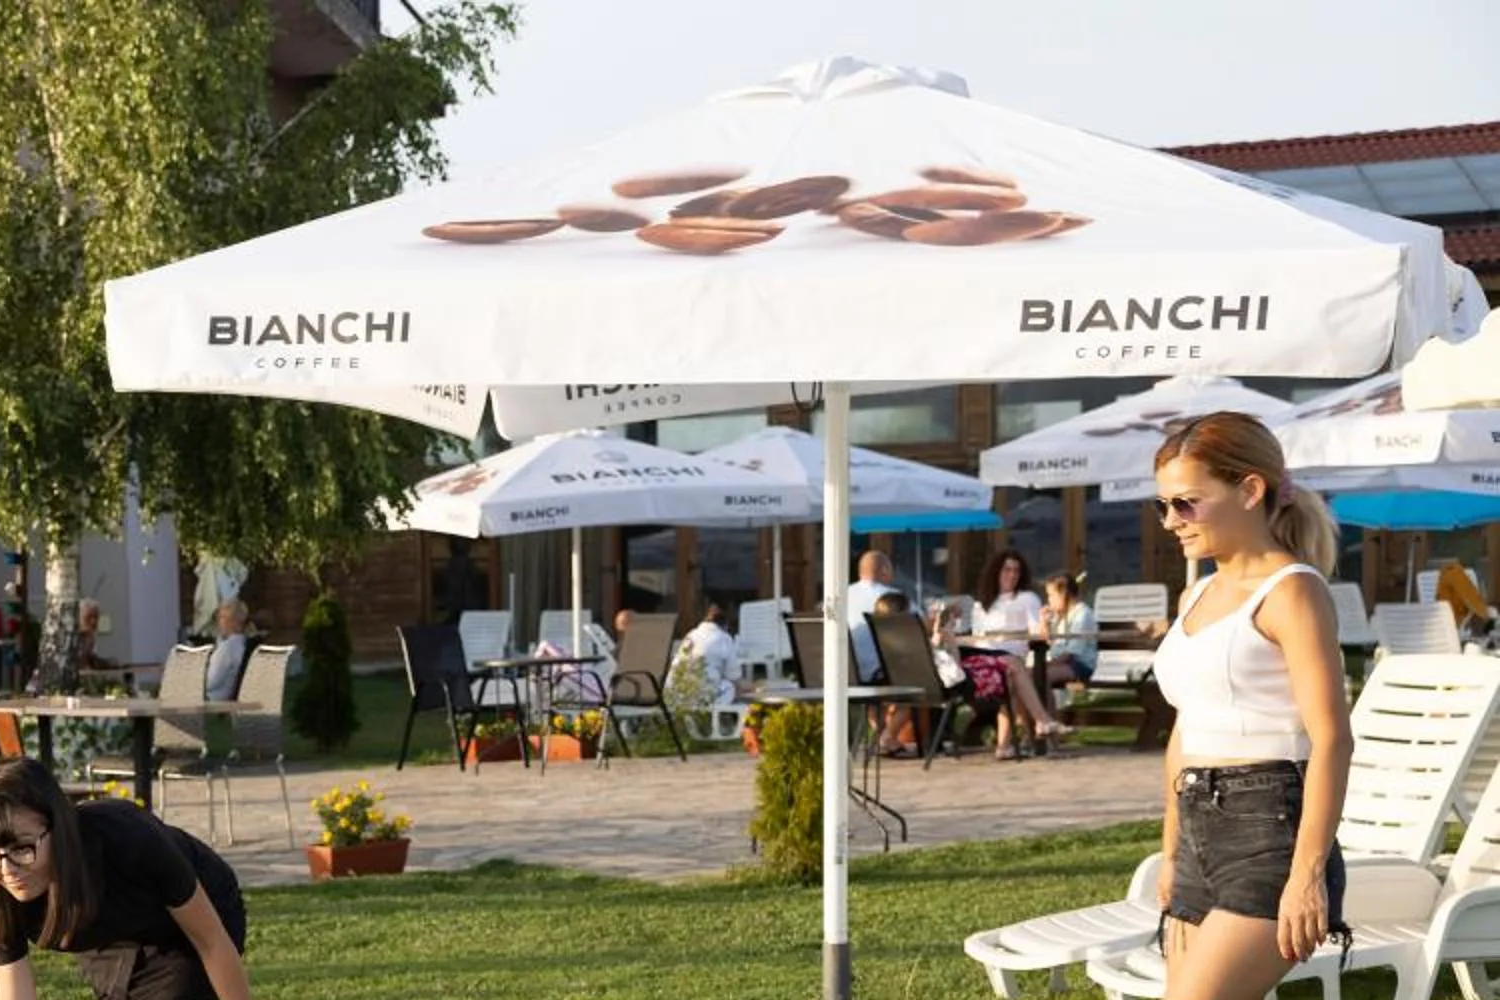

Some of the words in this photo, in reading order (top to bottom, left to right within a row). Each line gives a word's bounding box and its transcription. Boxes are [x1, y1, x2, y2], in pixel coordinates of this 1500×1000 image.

[1019, 295, 1270, 333] BIANCHI
[208, 311, 411, 346] BIANCHI
[1075, 344, 1203, 360] COFFEE
[256, 357, 361, 370] COFFEE
[1017, 457, 1088, 473] BIANCHI
[550, 465, 705, 484] BIANCHI
[724, 494, 782, 507] BIANCHI
[509, 504, 570, 522] BIANCHI
